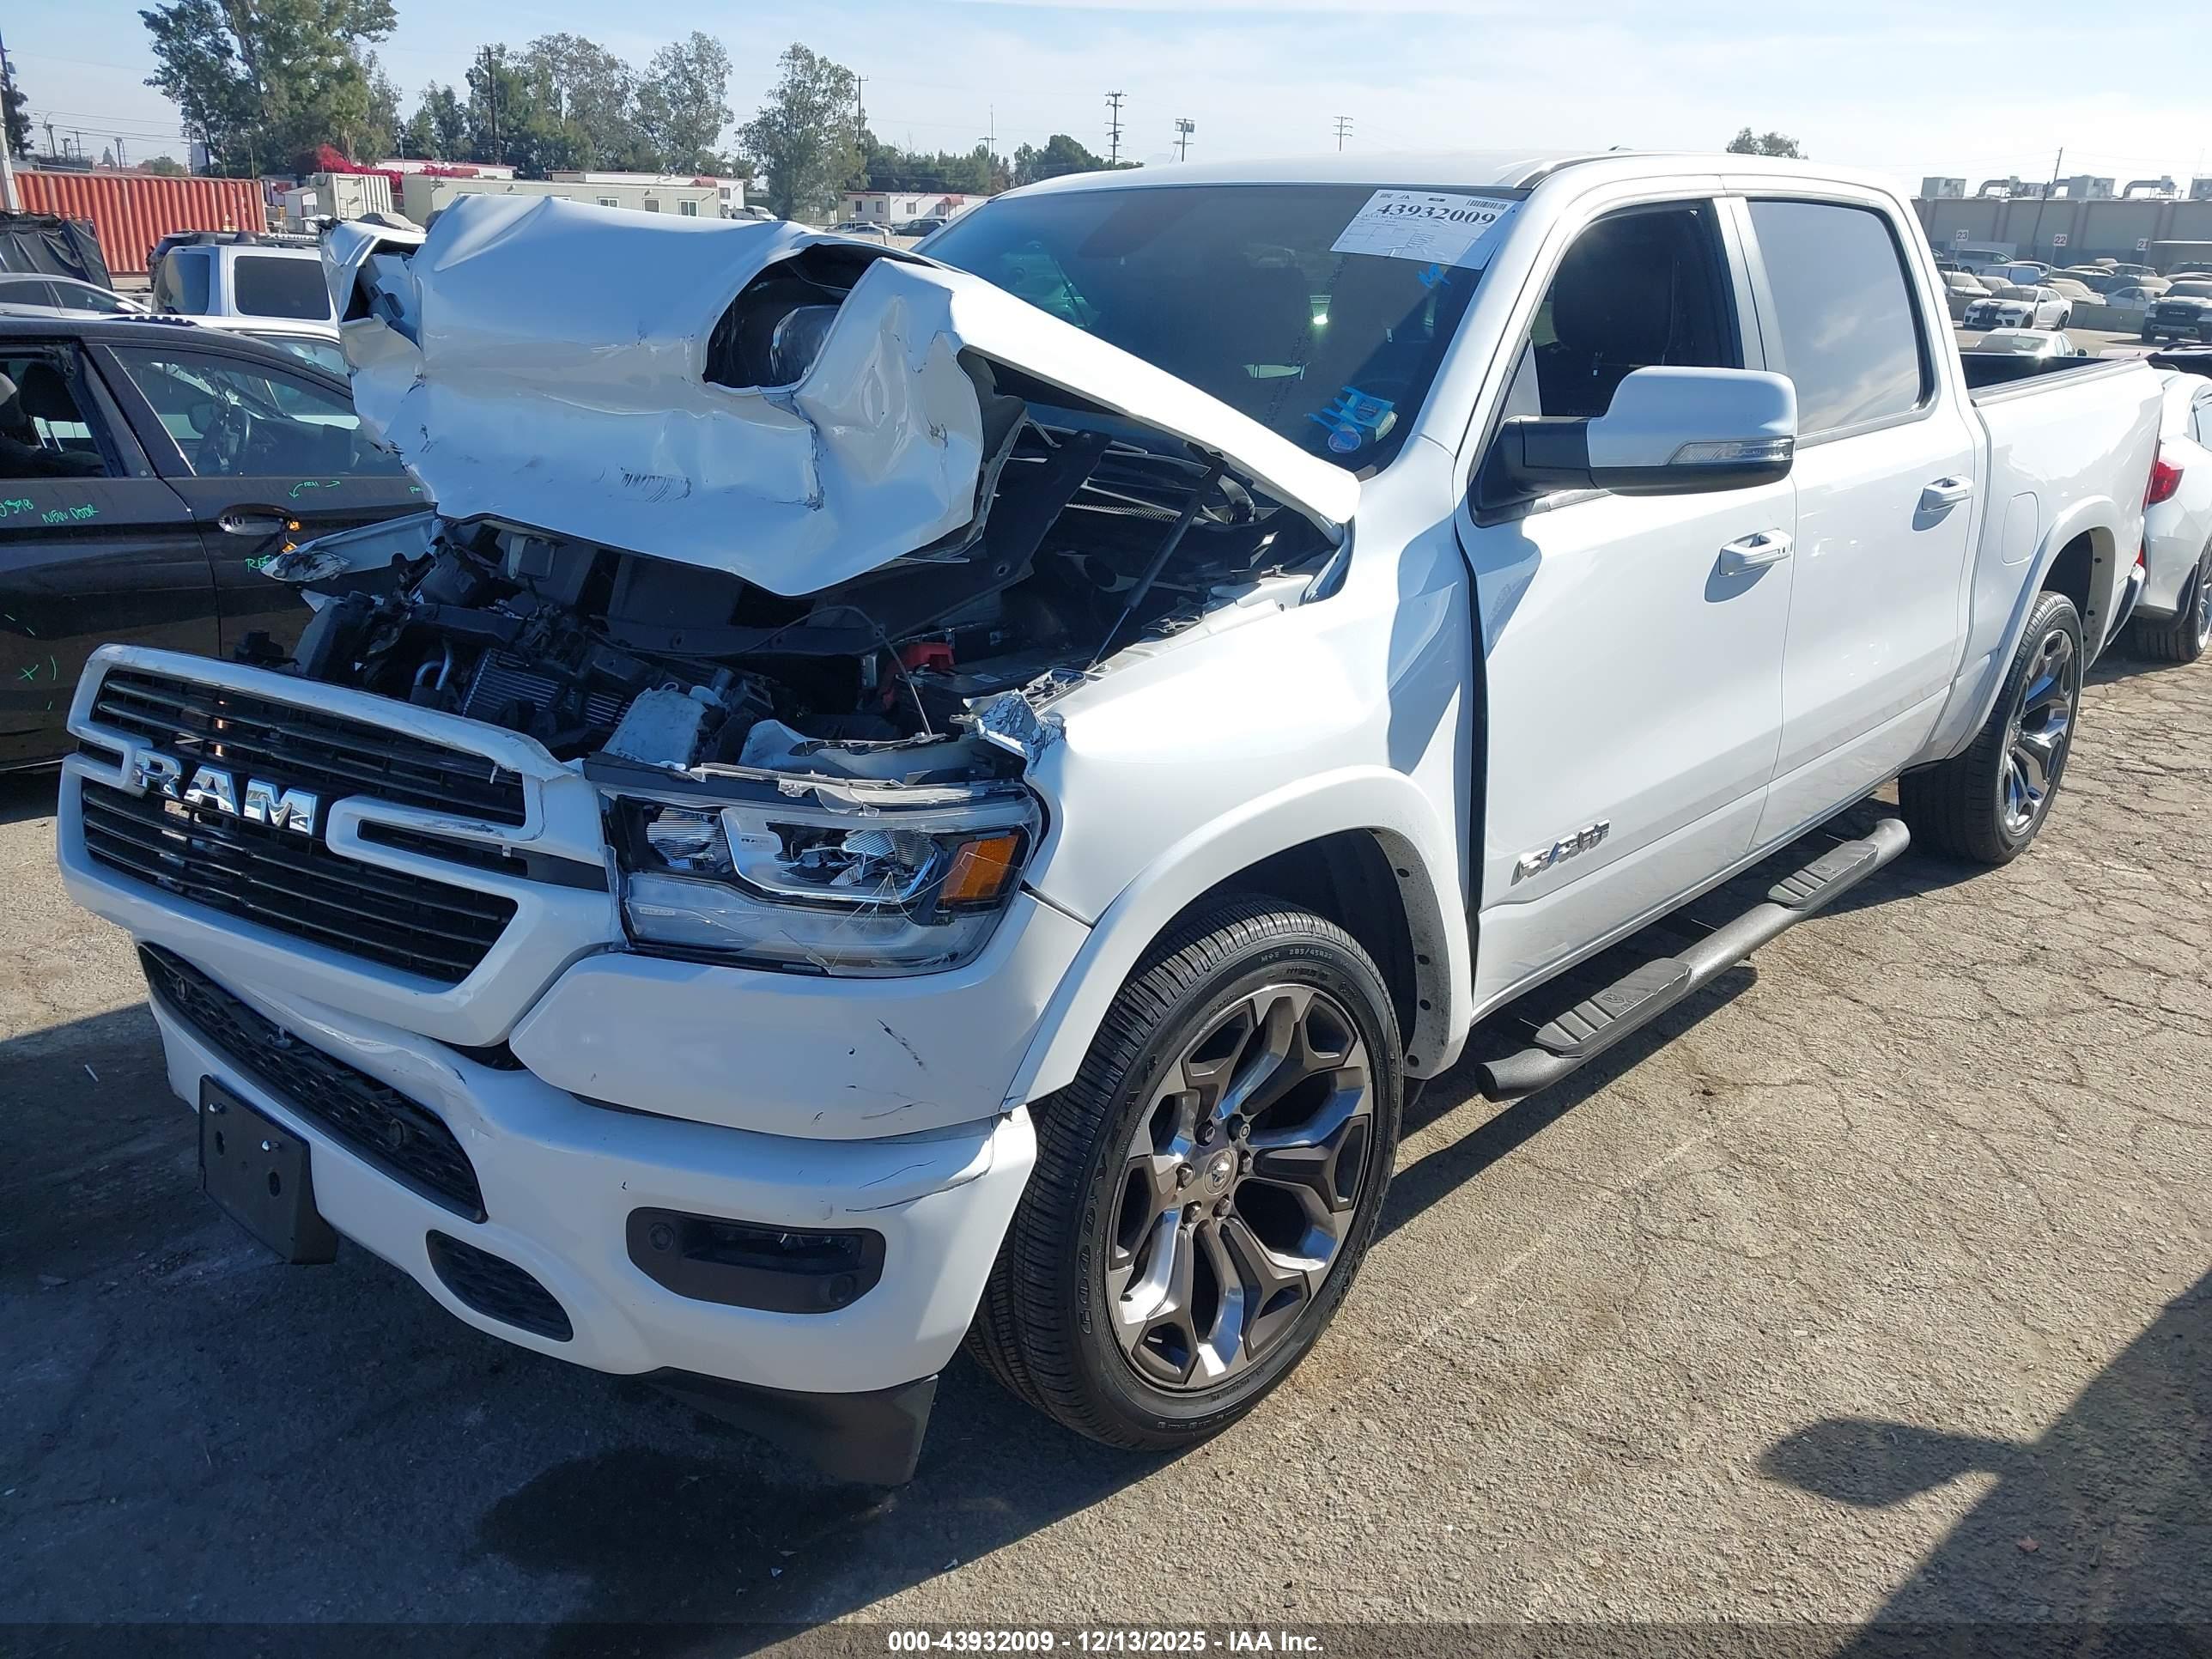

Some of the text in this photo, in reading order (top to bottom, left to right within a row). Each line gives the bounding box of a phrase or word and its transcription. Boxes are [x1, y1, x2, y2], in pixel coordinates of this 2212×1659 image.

[1376, 203, 1497, 225] 43932009
[1957, 231, 1967, 240] 23
[2054, 235, 2066, 245] 22
[134, 747, 319, 836] RAM
